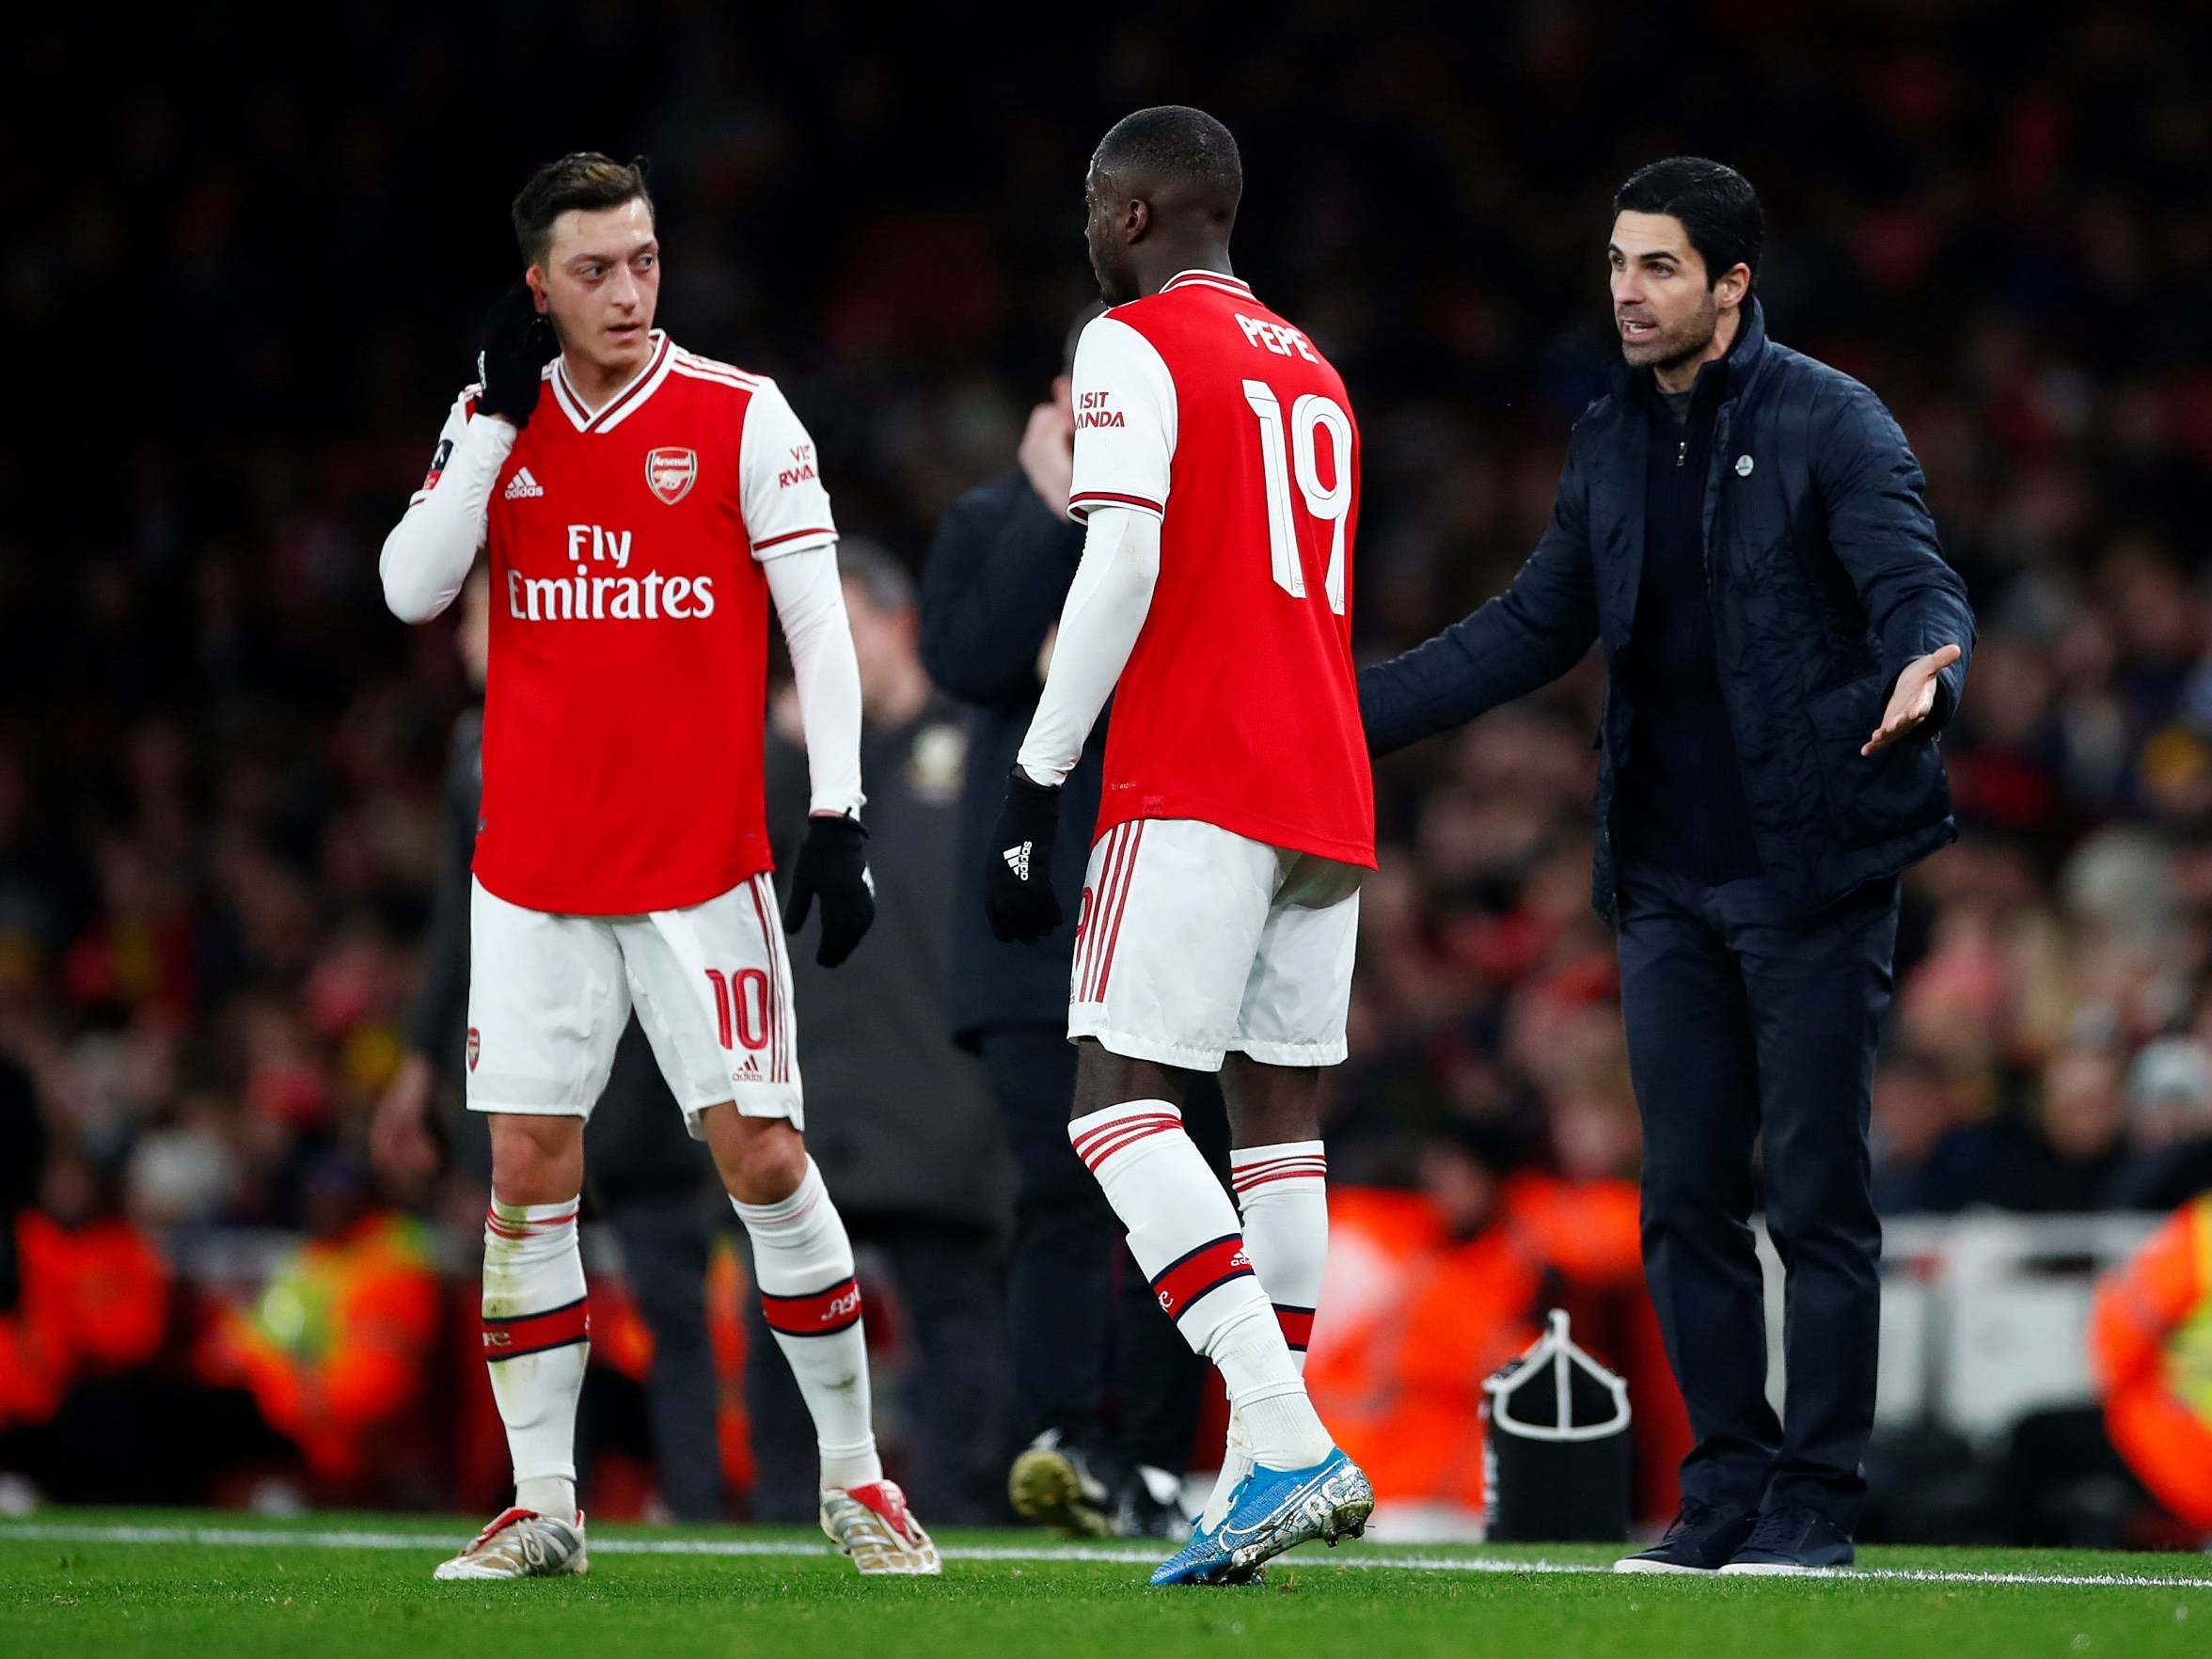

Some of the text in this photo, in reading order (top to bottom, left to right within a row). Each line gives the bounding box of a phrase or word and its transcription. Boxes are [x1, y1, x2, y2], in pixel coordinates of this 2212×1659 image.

[1234, 313, 1319, 365] PEPE
[504, 484, 544, 500] adidas
[1241, 379, 1352, 616] 19
[567, 524, 632, 569] Fly
[506, 564, 716, 622] Emirates
[1018, 841, 1033, 881] adidas
[704, 968, 769, 1051] 10
